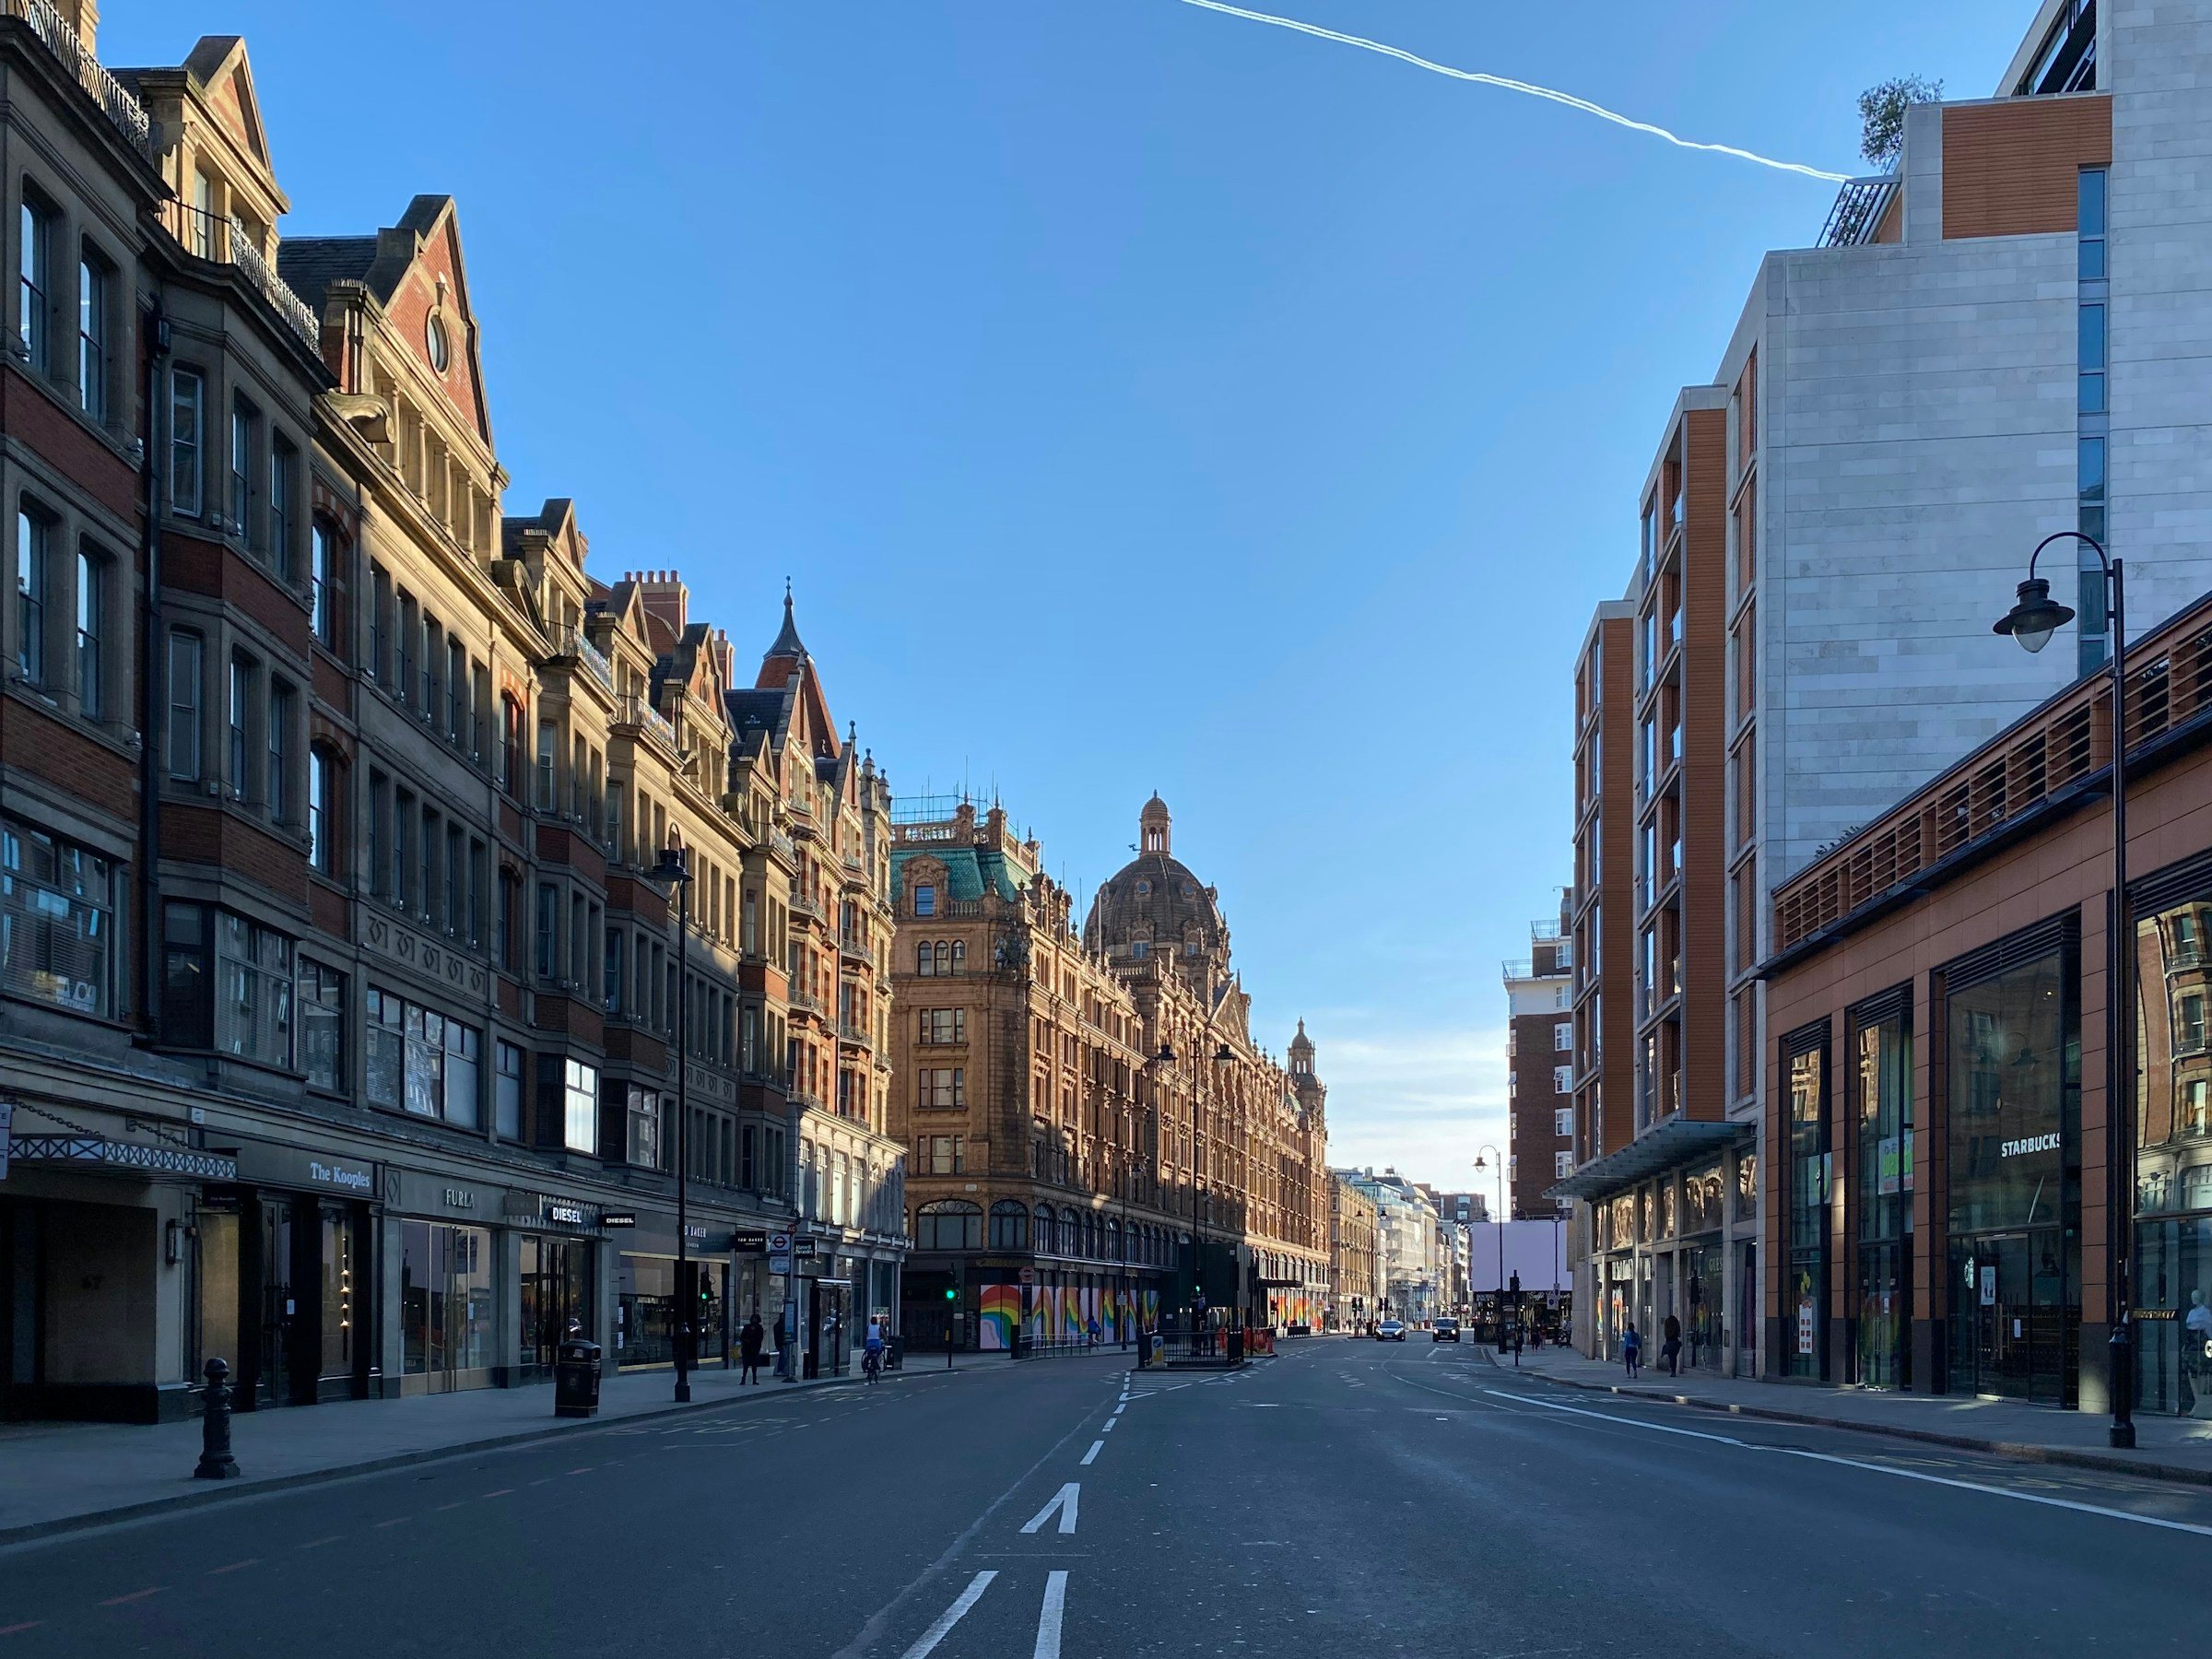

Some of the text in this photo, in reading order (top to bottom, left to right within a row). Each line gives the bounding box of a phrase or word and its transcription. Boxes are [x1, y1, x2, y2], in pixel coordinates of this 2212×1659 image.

[311, 1162, 371, 1189] The Kooples
[444, 1189, 475, 1208] FURLA
[552, 1206, 582, 1224] DIESEL
